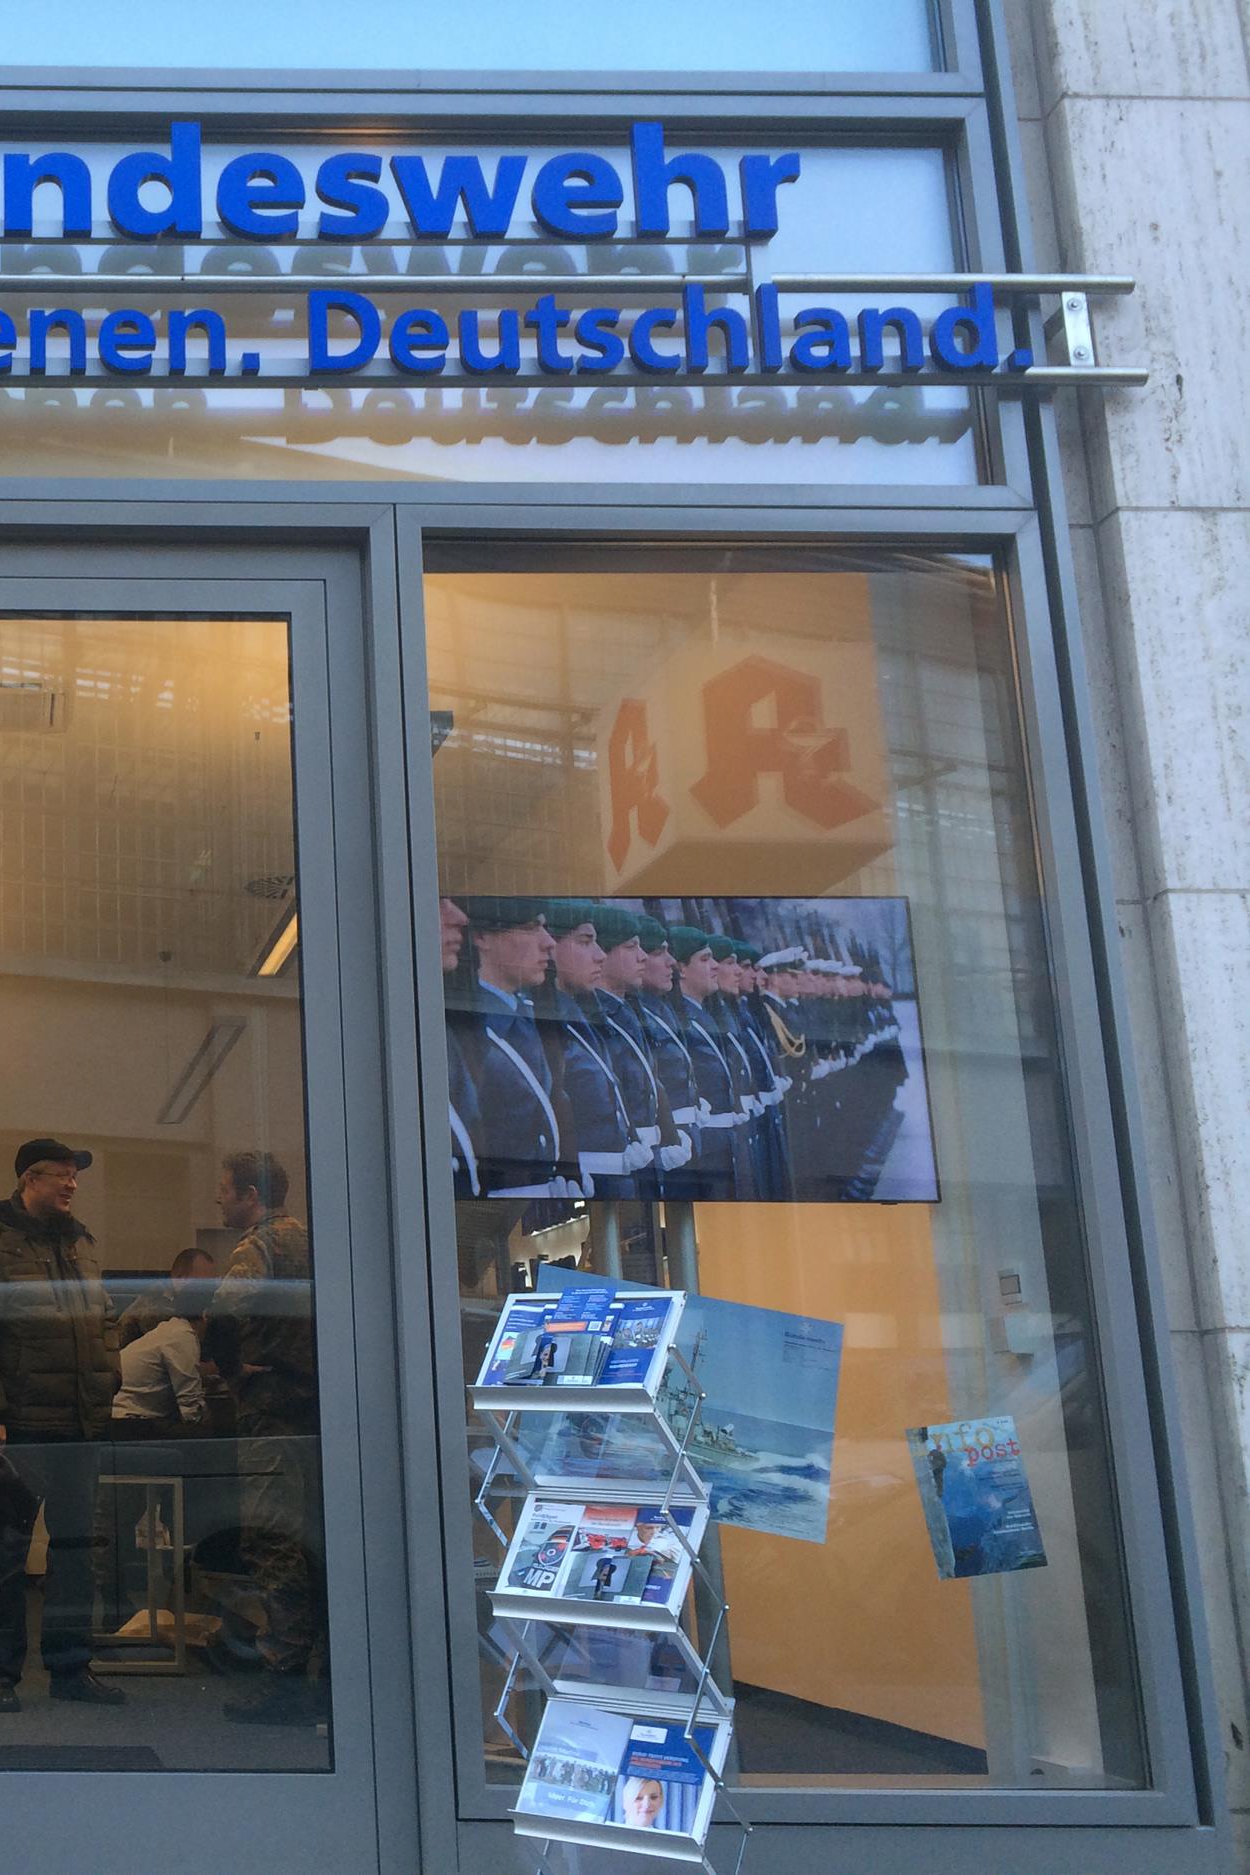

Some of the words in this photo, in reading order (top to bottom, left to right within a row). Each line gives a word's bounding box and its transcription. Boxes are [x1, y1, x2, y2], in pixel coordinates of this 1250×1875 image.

[307, 281, 1036, 375] Deutschland.
[964, 1438, 1021, 1467] post
[523, 1567, 556, 1589] MP
